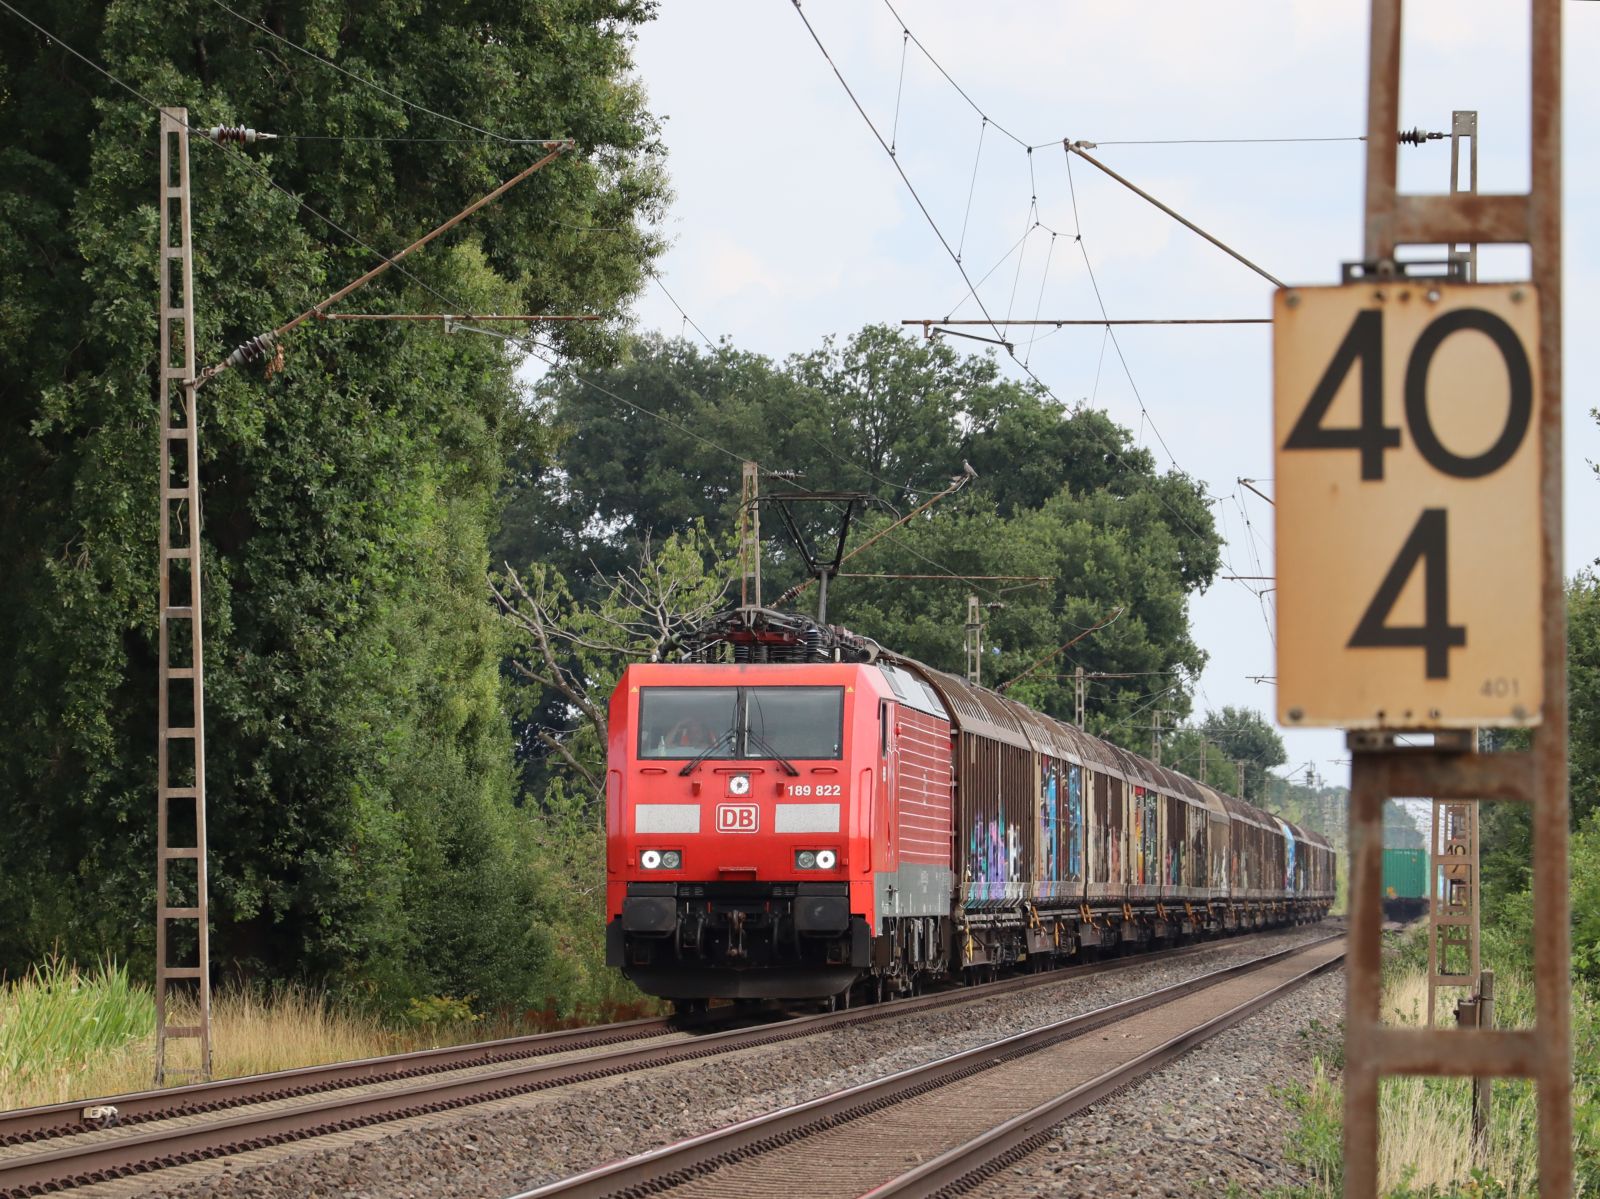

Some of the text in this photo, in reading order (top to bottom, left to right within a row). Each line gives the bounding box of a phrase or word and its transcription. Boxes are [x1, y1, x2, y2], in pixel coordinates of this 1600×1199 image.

[1281, 307, 1533, 482] 40
[1345, 507, 1467, 680] 4
[1479, 677, 1519, 698] 401
[787, 785, 841, 796] 189 822
[721, 808, 754, 828] DB
